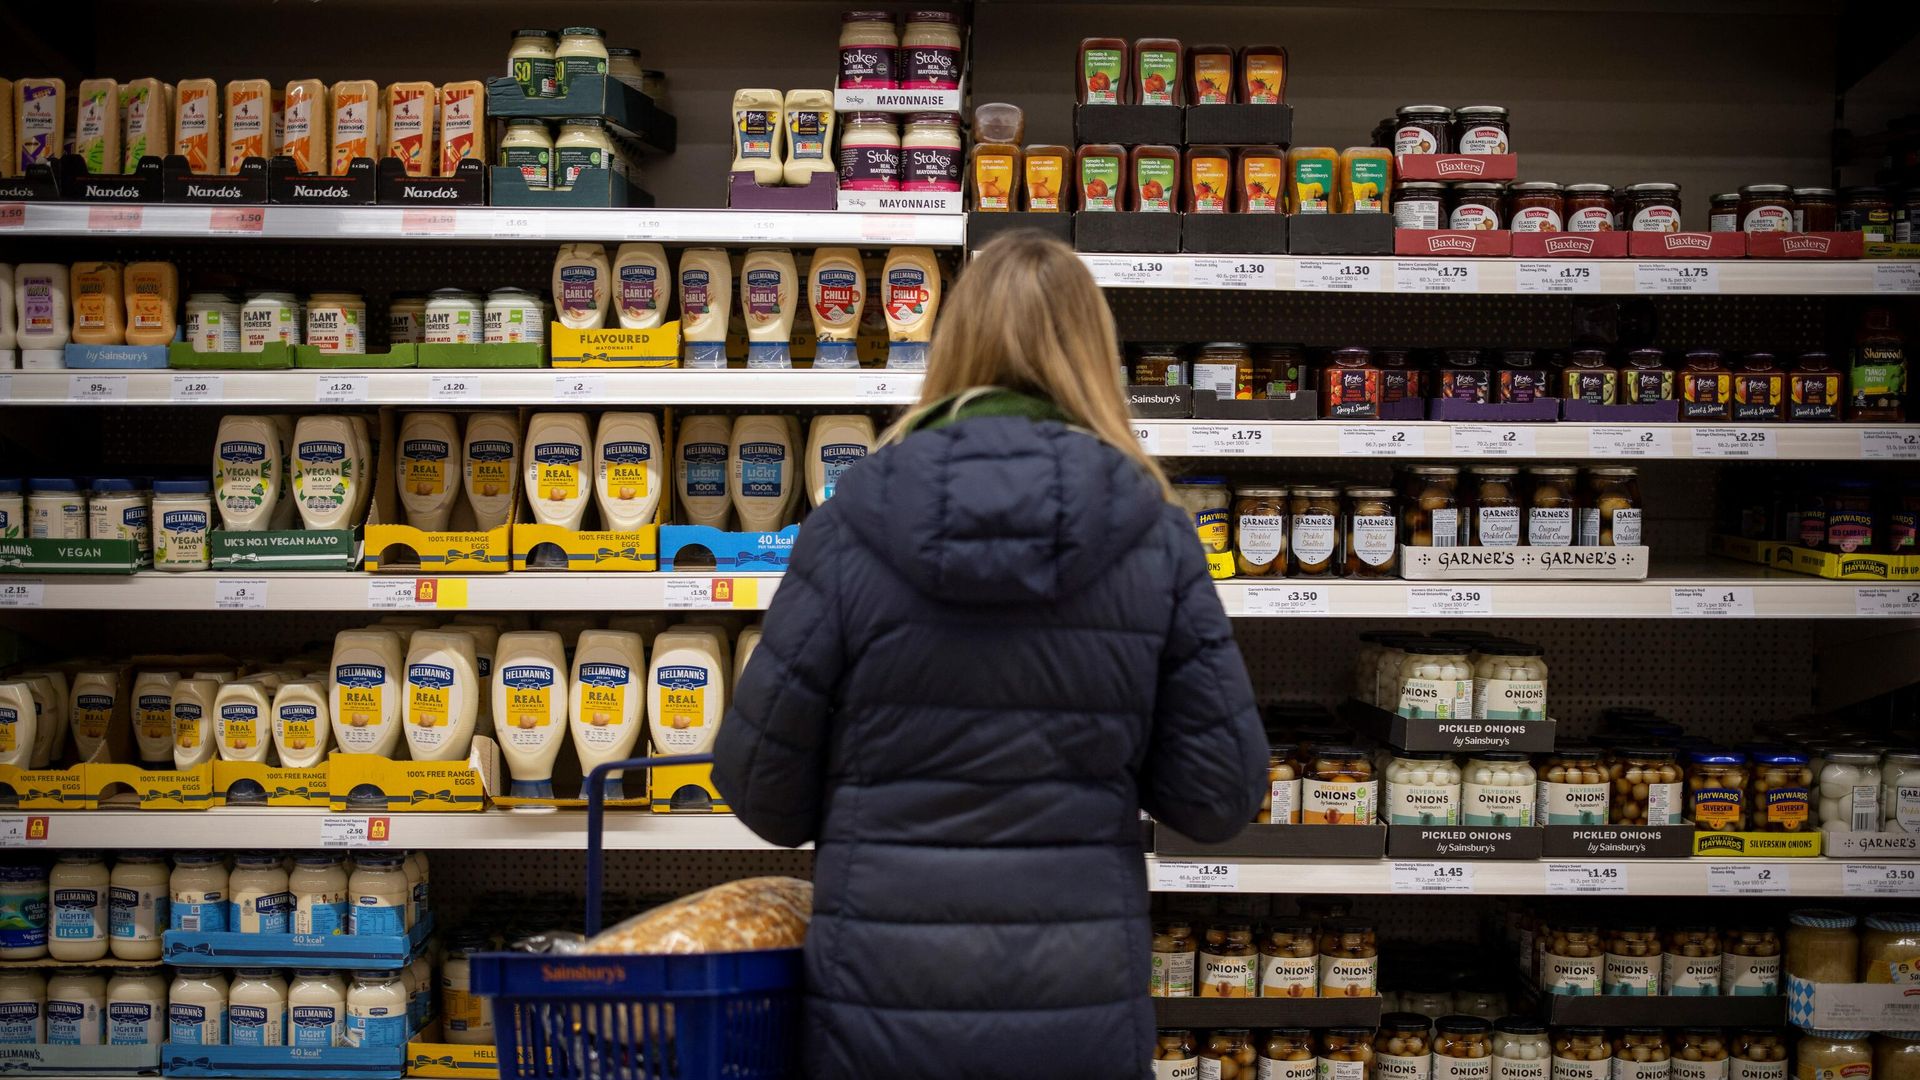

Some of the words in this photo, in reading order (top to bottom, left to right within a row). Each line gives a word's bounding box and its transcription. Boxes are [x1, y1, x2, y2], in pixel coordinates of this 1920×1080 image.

[843, 50, 877, 67] Stokes
[915, 51, 952, 67] Stokes
[846, 96, 864, 104] Stokes
[876, 96, 944, 105] MAYONNAISE
[914, 152, 950, 167] Stokes
[1440, 161, 1482, 172] Baxters
[86, 185, 139, 198] Nando's
[187, 185, 242, 198] Nando's
[294, 185, 349, 198] Nando's
[403, 186, 458, 199] Nando's
[879, 199, 946, 208] MAYONNAISE
[1431, 237, 1472, 249] Baxters
[1549, 239, 1590, 251] Baxters
[1668, 235, 1709, 248] Baxters
[1786, 238, 1828, 251] Baxters
[1132, 263, 1162, 272] £1.30
[1234, 264, 1264, 273] £1.30
[1340, 266, 1370, 275] £1.30
[1438, 267, 1467, 277] £1.75
[1560, 268, 1590, 277] £1.75
[1679, 268, 1708, 277] £1.75
[565, 288, 593, 299] GARLIC
[824, 290, 850, 301] CHILLI
[244, 311, 272, 320] PLANT
[309, 312, 338, 322] PLANT
[580, 334, 650, 344] FLAVOURED
[86, 351, 98, 361] by
[100, 350, 148, 361] Sainsbury's
[90, 384, 106, 393] 95p
[330, 383, 352, 391] £1.20
[443, 383, 465, 391] £1.20
[574, 383, 583, 391] £2
[1131, 394, 1180, 404] Sainsbury's
[1232, 430, 1262, 440] £1.75
[1392, 432, 1405, 442] £2
[1503, 432, 1516, 441] £2
[1640, 432, 1654, 442] £2
[1736, 433, 1765, 442] £2.25
[222, 444, 263, 455] HELLMANN'S
[538, 445, 580, 457] HELLMANN'S
[226, 468, 258, 477] VEGAN
[545, 469, 571, 478] REAL
[165, 513, 206, 524] HELLMANN'S
[1241, 517, 1279, 527] GARNER'S
[1830, 514, 1871, 526] HAYWARDS
[1538, 524, 1561, 534] Original
[171, 536, 202, 545] VEGAN
[224, 538, 244, 548] UK'S
[246, 537, 268, 547] NO.1
[270, 537, 304, 546] VEGAN
[306, 536, 338, 546] MAYO
[758, 535, 772, 545] 40
[775, 535, 794, 545] kcal
[1249, 540, 1272, 548] Shallots
[58, 548, 101, 557] VEGAN
[1438, 552, 1514, 572] GARNER'S
[1540, 552, 1616, 572] GARNER'S
[1843, 564, 1885, 576] HAYWARDS
[1891, 567, 1909, 575] LIVEN
[1911, 567, 1919, 575] UP
[236, 588, 246, 596] £3
[1288, 592, 1317, 601] £3.50
[1451, 592, 1480, 601] £3.50
[1723, 592, 1735, 602] £1
[1907, 592, 1920, 602] £2
[338, 668, 382, 679] HELLMANN'S
[505, 669, 551, 680] HELLMANN'S
[582, 667, 626, 678] HELLMANN'S
[347, 693, 374, 702] REAL
[514, 695, 542, 704] REAL
[588, 692, 616, 702] REAL
[1438, 724, 1482, 734] PICKLED
[1484, 724, 1526, 734] ONIONS
[1453, 736, 1464, 746] by
[1465, 736, 1510, 746] Sainsbury's
[406, 770, 425, 778] 100%
[427, 770, 446, 778] FREE
[447, 770, 475, 778] RANGE
[454, 778, 475, 786] EGGS
[1313, 790, 1356, 801] ONIONS
[1406, 794, 1449, 804] ONIONS
[1698, 792, 1738, 802] HAYWARDS
[1702, 804, 1733, 812] SILVERSKIN
[1422, 831, 1467, 840] PICKLED
[1469, 832, 1512, 841] ONIONS
[1572, 831, 1618, 840] PICKLED
[1620, 831, 1662, 840] ONIONS
[1436, 842, 1448, 853] by
[1449, 842, 1496, 852] Sainsbury's
[1701, 839, 1743, 850] HAYWARDS
[1750, 839, 1787, 848] SILVERSKIN
[1788, 839, 1813, 848] ONIONS
[1859, 838, 1916, 852] GARNER'S
[1199, 866, 1228, 875] £1.45
[1434, 867, 1463, 877] £1.45
[1588, 868, 1617, 878] £1.45
[1758, 869, 1771, 879] £2
[1886, 870, 1915, 880] £3.50
[68, 927, 89, 935] CALS
[292, 935, 305, 943] 40
[1206, 963, 1247, 974] ONIONS
[1554, 964, 1595, 975] ONIONS
[542, 964, 626, 984] Sainsbury's
[290, 1048, 302, 1056] 40
